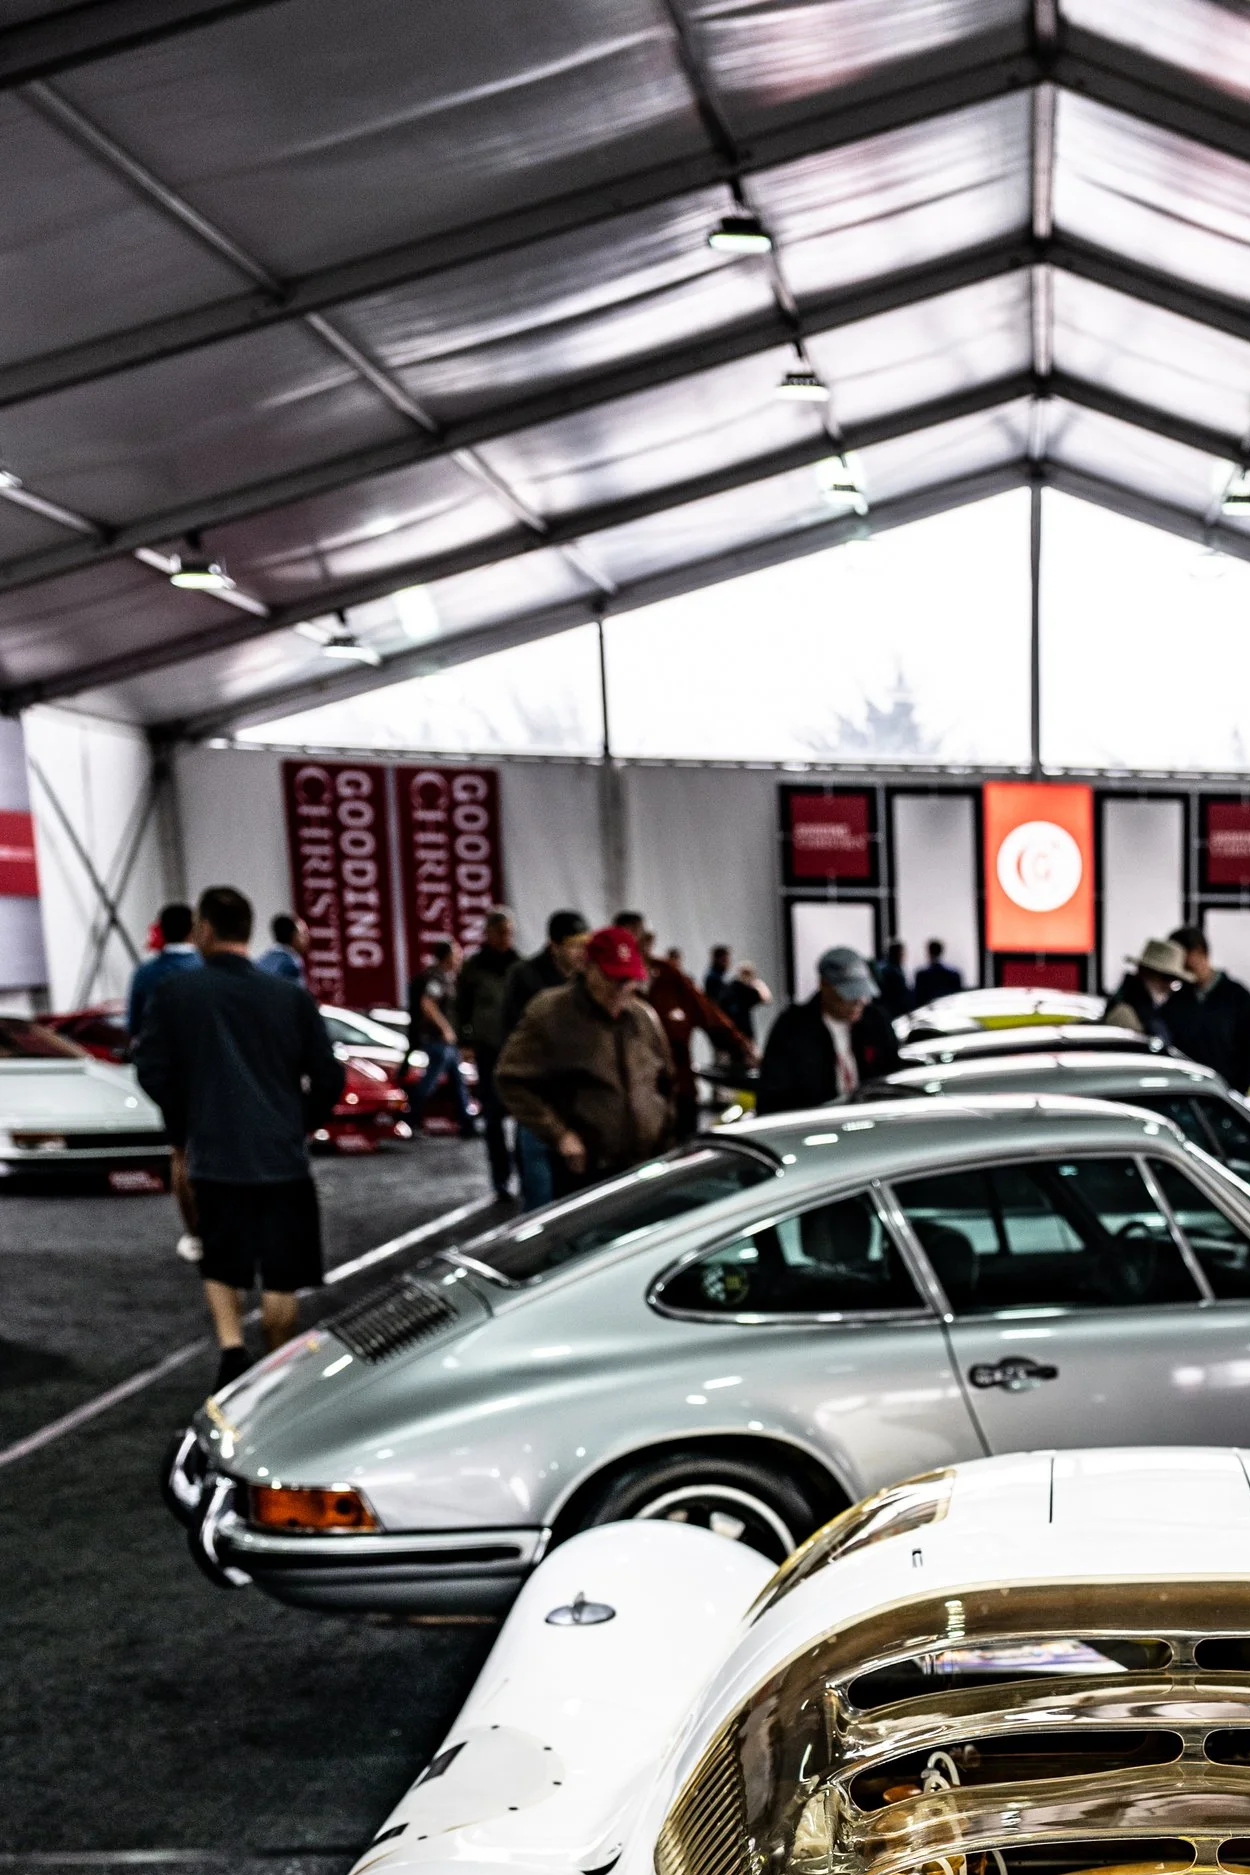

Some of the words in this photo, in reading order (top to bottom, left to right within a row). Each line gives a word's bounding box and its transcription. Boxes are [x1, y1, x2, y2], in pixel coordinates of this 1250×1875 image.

[335, 769, 384, 968] GOODING
[410, 771, 452, 966] CHRIST
[452, 774, 491, 957] GOODIN
